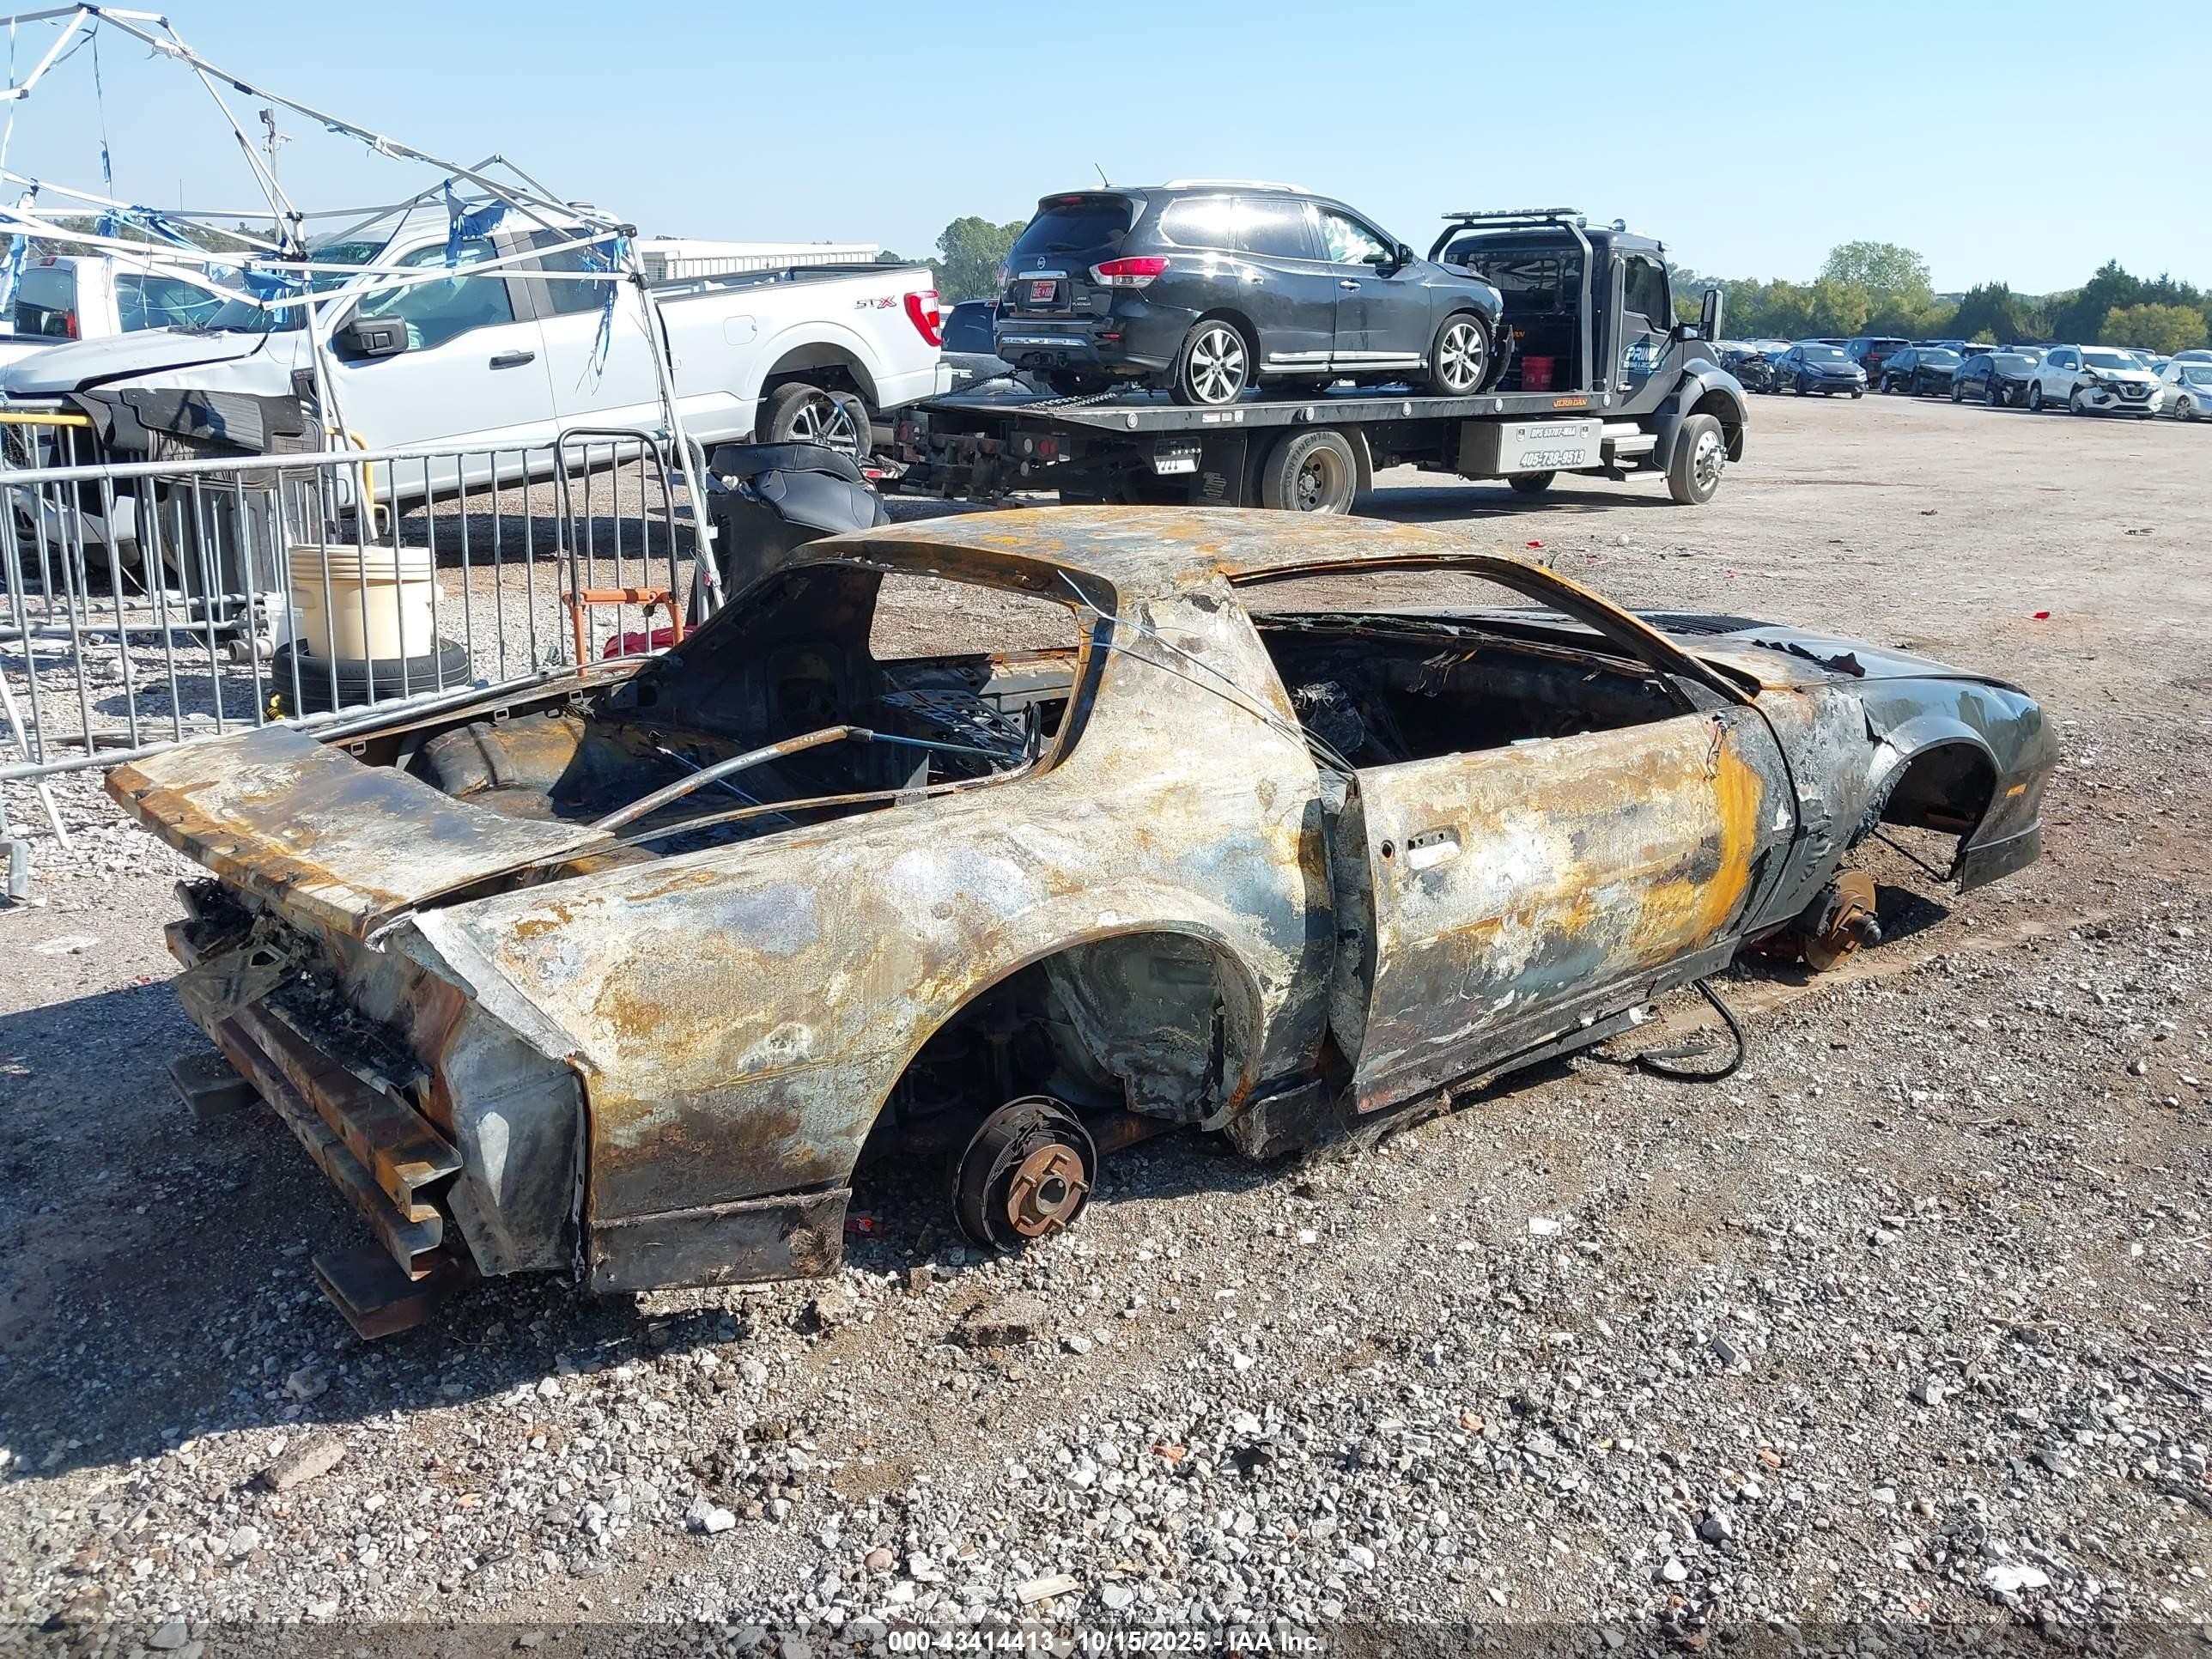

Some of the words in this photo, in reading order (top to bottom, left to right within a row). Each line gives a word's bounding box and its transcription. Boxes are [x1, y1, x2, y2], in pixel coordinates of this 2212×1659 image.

[854, 295, 896, 309] STX
[1530, 428, 1543, 439] DPS
[1284, 432, 1332, 487] CONTINENTAL
[1520, 448, 1586, 468] 405-738-9513
